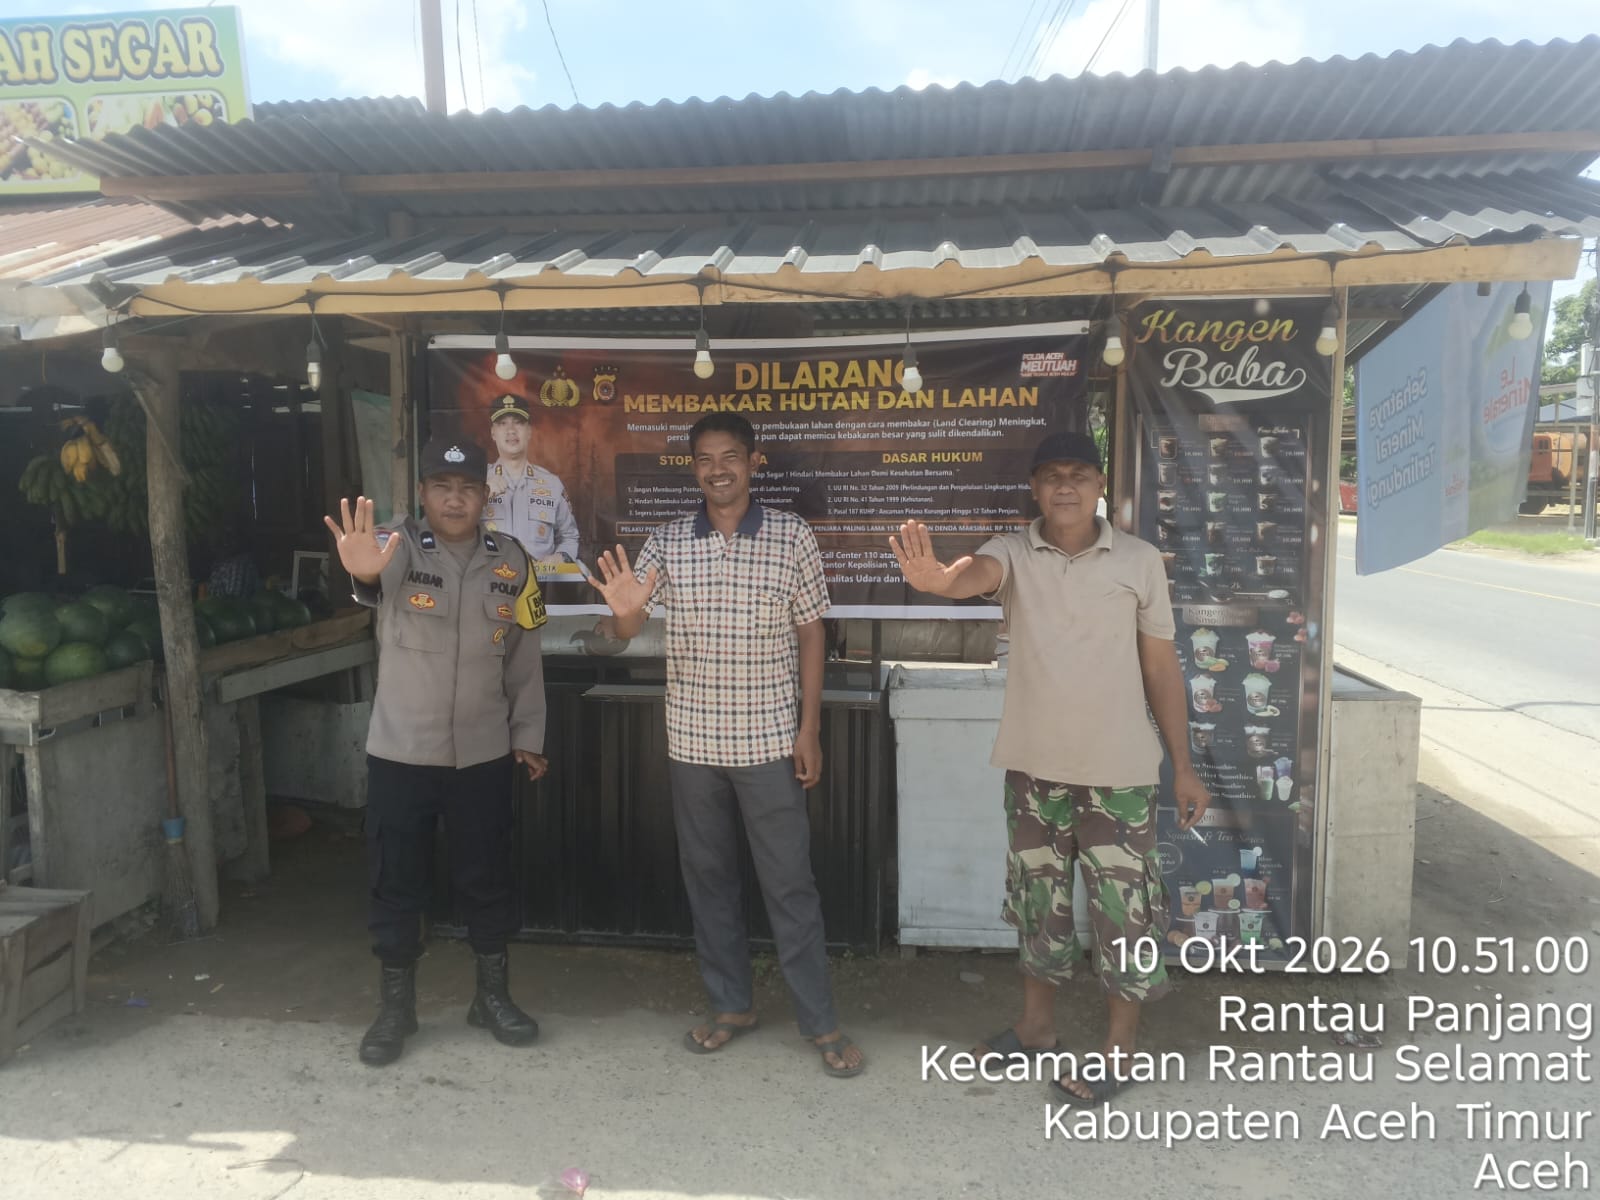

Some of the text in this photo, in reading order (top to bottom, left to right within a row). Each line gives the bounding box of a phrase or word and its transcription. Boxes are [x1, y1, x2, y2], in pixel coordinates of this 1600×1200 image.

[62, 19, 223, 81] SEGAR
[1136, 309, 1298, 351] Kangen
[1020, 360, 1078, 372] MEUTUAH
[1160, 346, 1306, 398] Boba
[624, 387, 1038, 413] MEMBAKAR HUTAN DAN LAHAN
[627, 423, 668, 433] Memasuki
[762, 421, 808, 432] pembukaan
[812, 421, 833, 430] lahan
[834, 421, 867, 432] dengan
[868, 421, 885, 429] cara
[887, 419, 931, 428] membakar
[933, 418, 957, 429] (Land
[958, 418, 997, 430] Clearing)
[761, 434, 777, 443] pun
[778, 432, 801, 442] dapat
[803, 431, 836, 440] memicu
[838, 430, 880, 439] kebakaran
[881, 429, 903, 438] besar
[906, 430, 926, 441] yang
[928, 428, 946, 437] sulit
[948, 428, 1004, 438] dikendalikan.
[659, 456, 693, 466] STOP
[882, 452, 983, 463] DASAR HUKUM
[766, 471, 784, 480] Segar
[815, 470, 849, 478] Membakar
[850, 469, 870, 477] Lahan
[530, 498, 554, 508] POLRI
[821, 551, 834, 559] Call
[835, 551, 862, 559] Center
[864, 551, 878, 559] 110
[847, 561, 888, 570] Kepolisian
[408, 570, 444, 588] AKBAR
[826, 574, 854, 583] ualitas
[856, 574, 882, 583] Udara
[883, 574, 900, 583] dan
